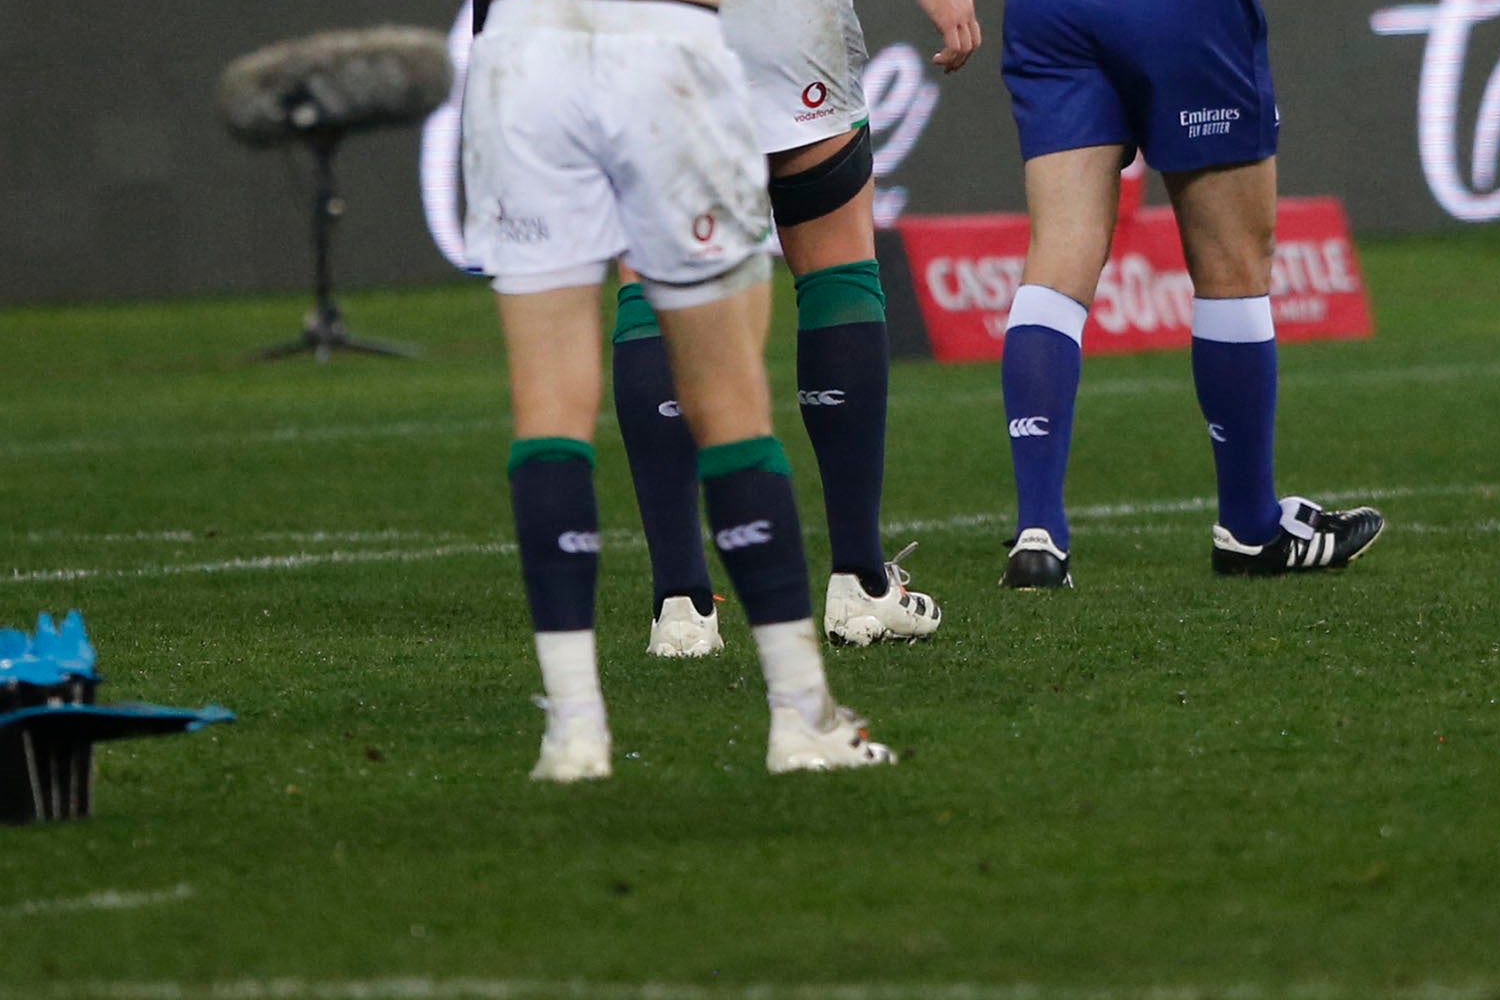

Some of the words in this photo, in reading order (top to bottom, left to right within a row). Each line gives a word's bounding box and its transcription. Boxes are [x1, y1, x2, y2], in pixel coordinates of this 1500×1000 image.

[795, 108, 834, 122] vodafone
[1180, 107, 1240, 126] Emirates
[1188, 125, 1201, 138] FLY
[1202, 121, 1231, 136] BETTER
[1270, 238, 1356, 298] STLE
